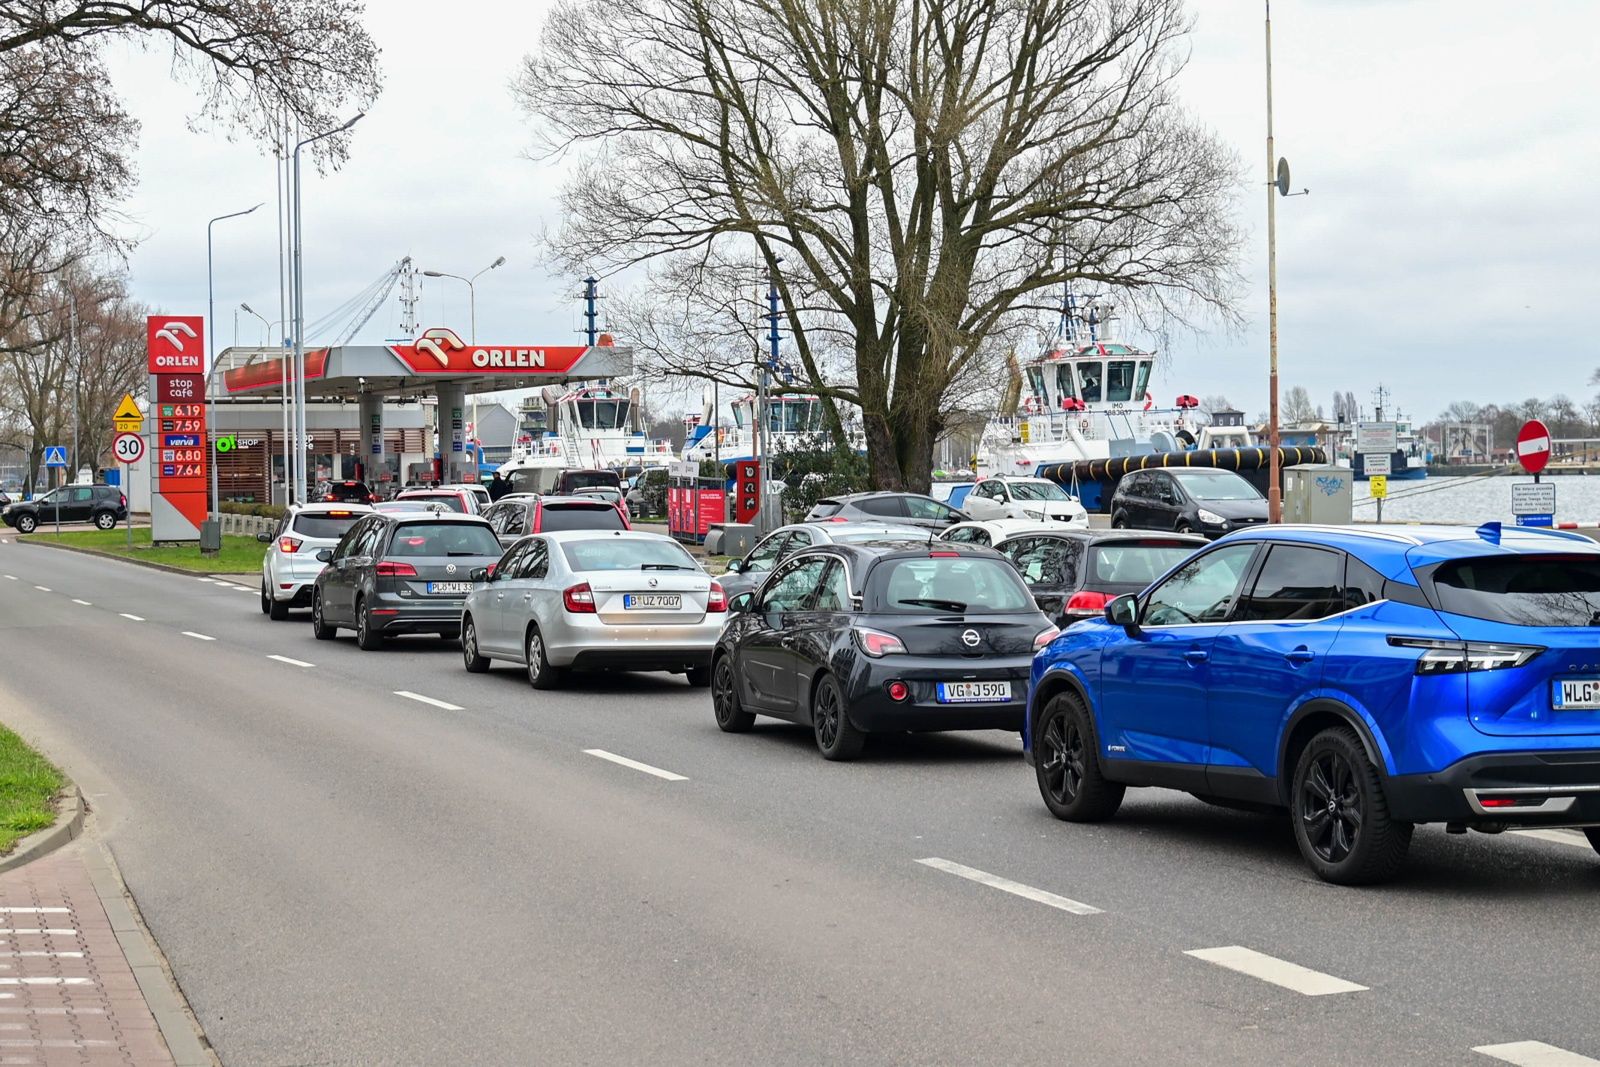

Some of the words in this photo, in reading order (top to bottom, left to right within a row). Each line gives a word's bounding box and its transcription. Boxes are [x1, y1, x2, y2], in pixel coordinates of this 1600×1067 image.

[156, 356, 199, 366] ORLEN
[472, 349, 545, 367] ORLEN
[169, 379, 193, 389] stop
[169, 388, 193, 397] cafe
[175, 405, 201, 416] 6.19
[175, 420, 201, 432] 7.59
[118, 440, 139, 455] 30
[176, 450, 202, 461] 6.80
[176, 465, 202, 476] 7.64
[630, 597, 637, 606] B
[642, 596, 655, 606] UZ
[658, 595, 680, 606] 7007
[948, 684, 965, 697] VG
[973, 684, 981, 697] J
[982, 683, 1006, 696] 590
[1563, 683, 1592, 702] WLG
